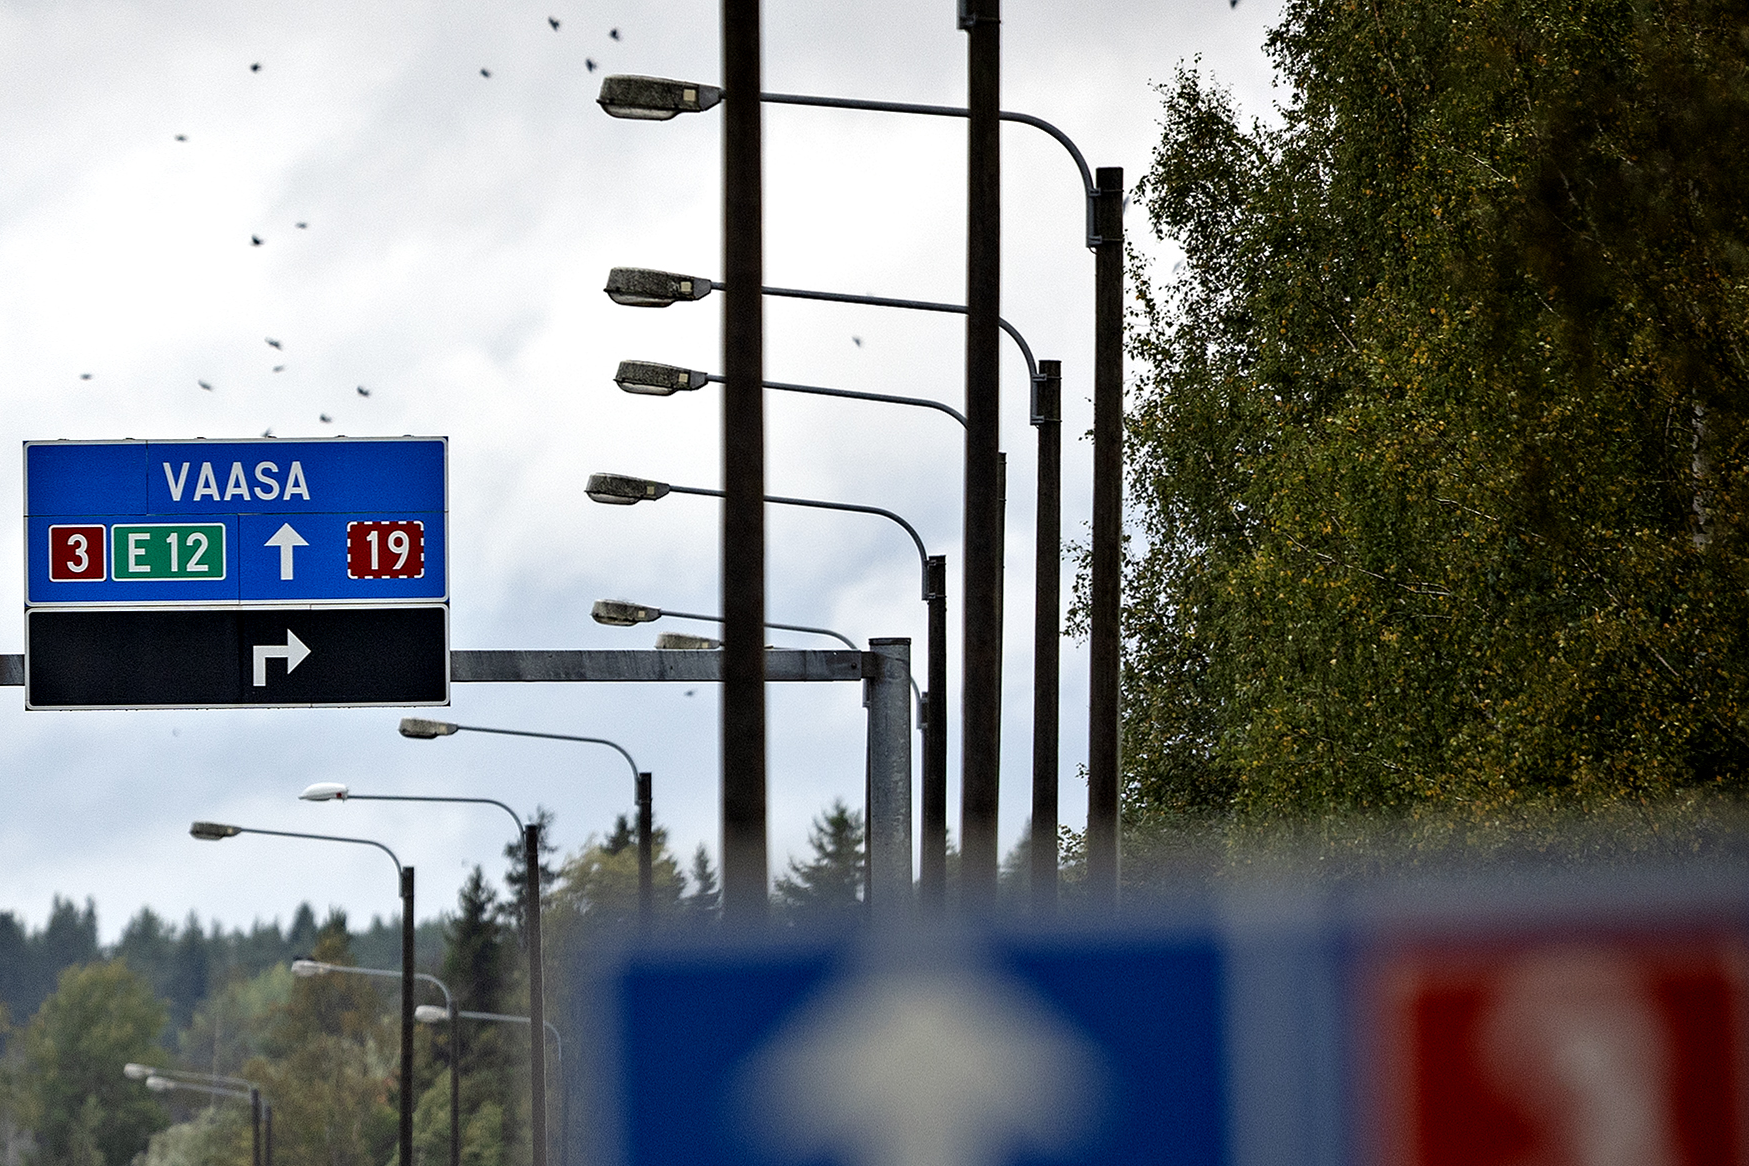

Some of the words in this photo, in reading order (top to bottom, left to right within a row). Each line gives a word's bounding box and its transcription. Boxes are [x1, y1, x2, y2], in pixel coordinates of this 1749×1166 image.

[163, 461, 311, 501] VAASA
[66, 534, 89, 573] 3
[128, 533, 151, 572] E
[166, 532, 209, 572] 12
[366, 530, 410, 570] 19
